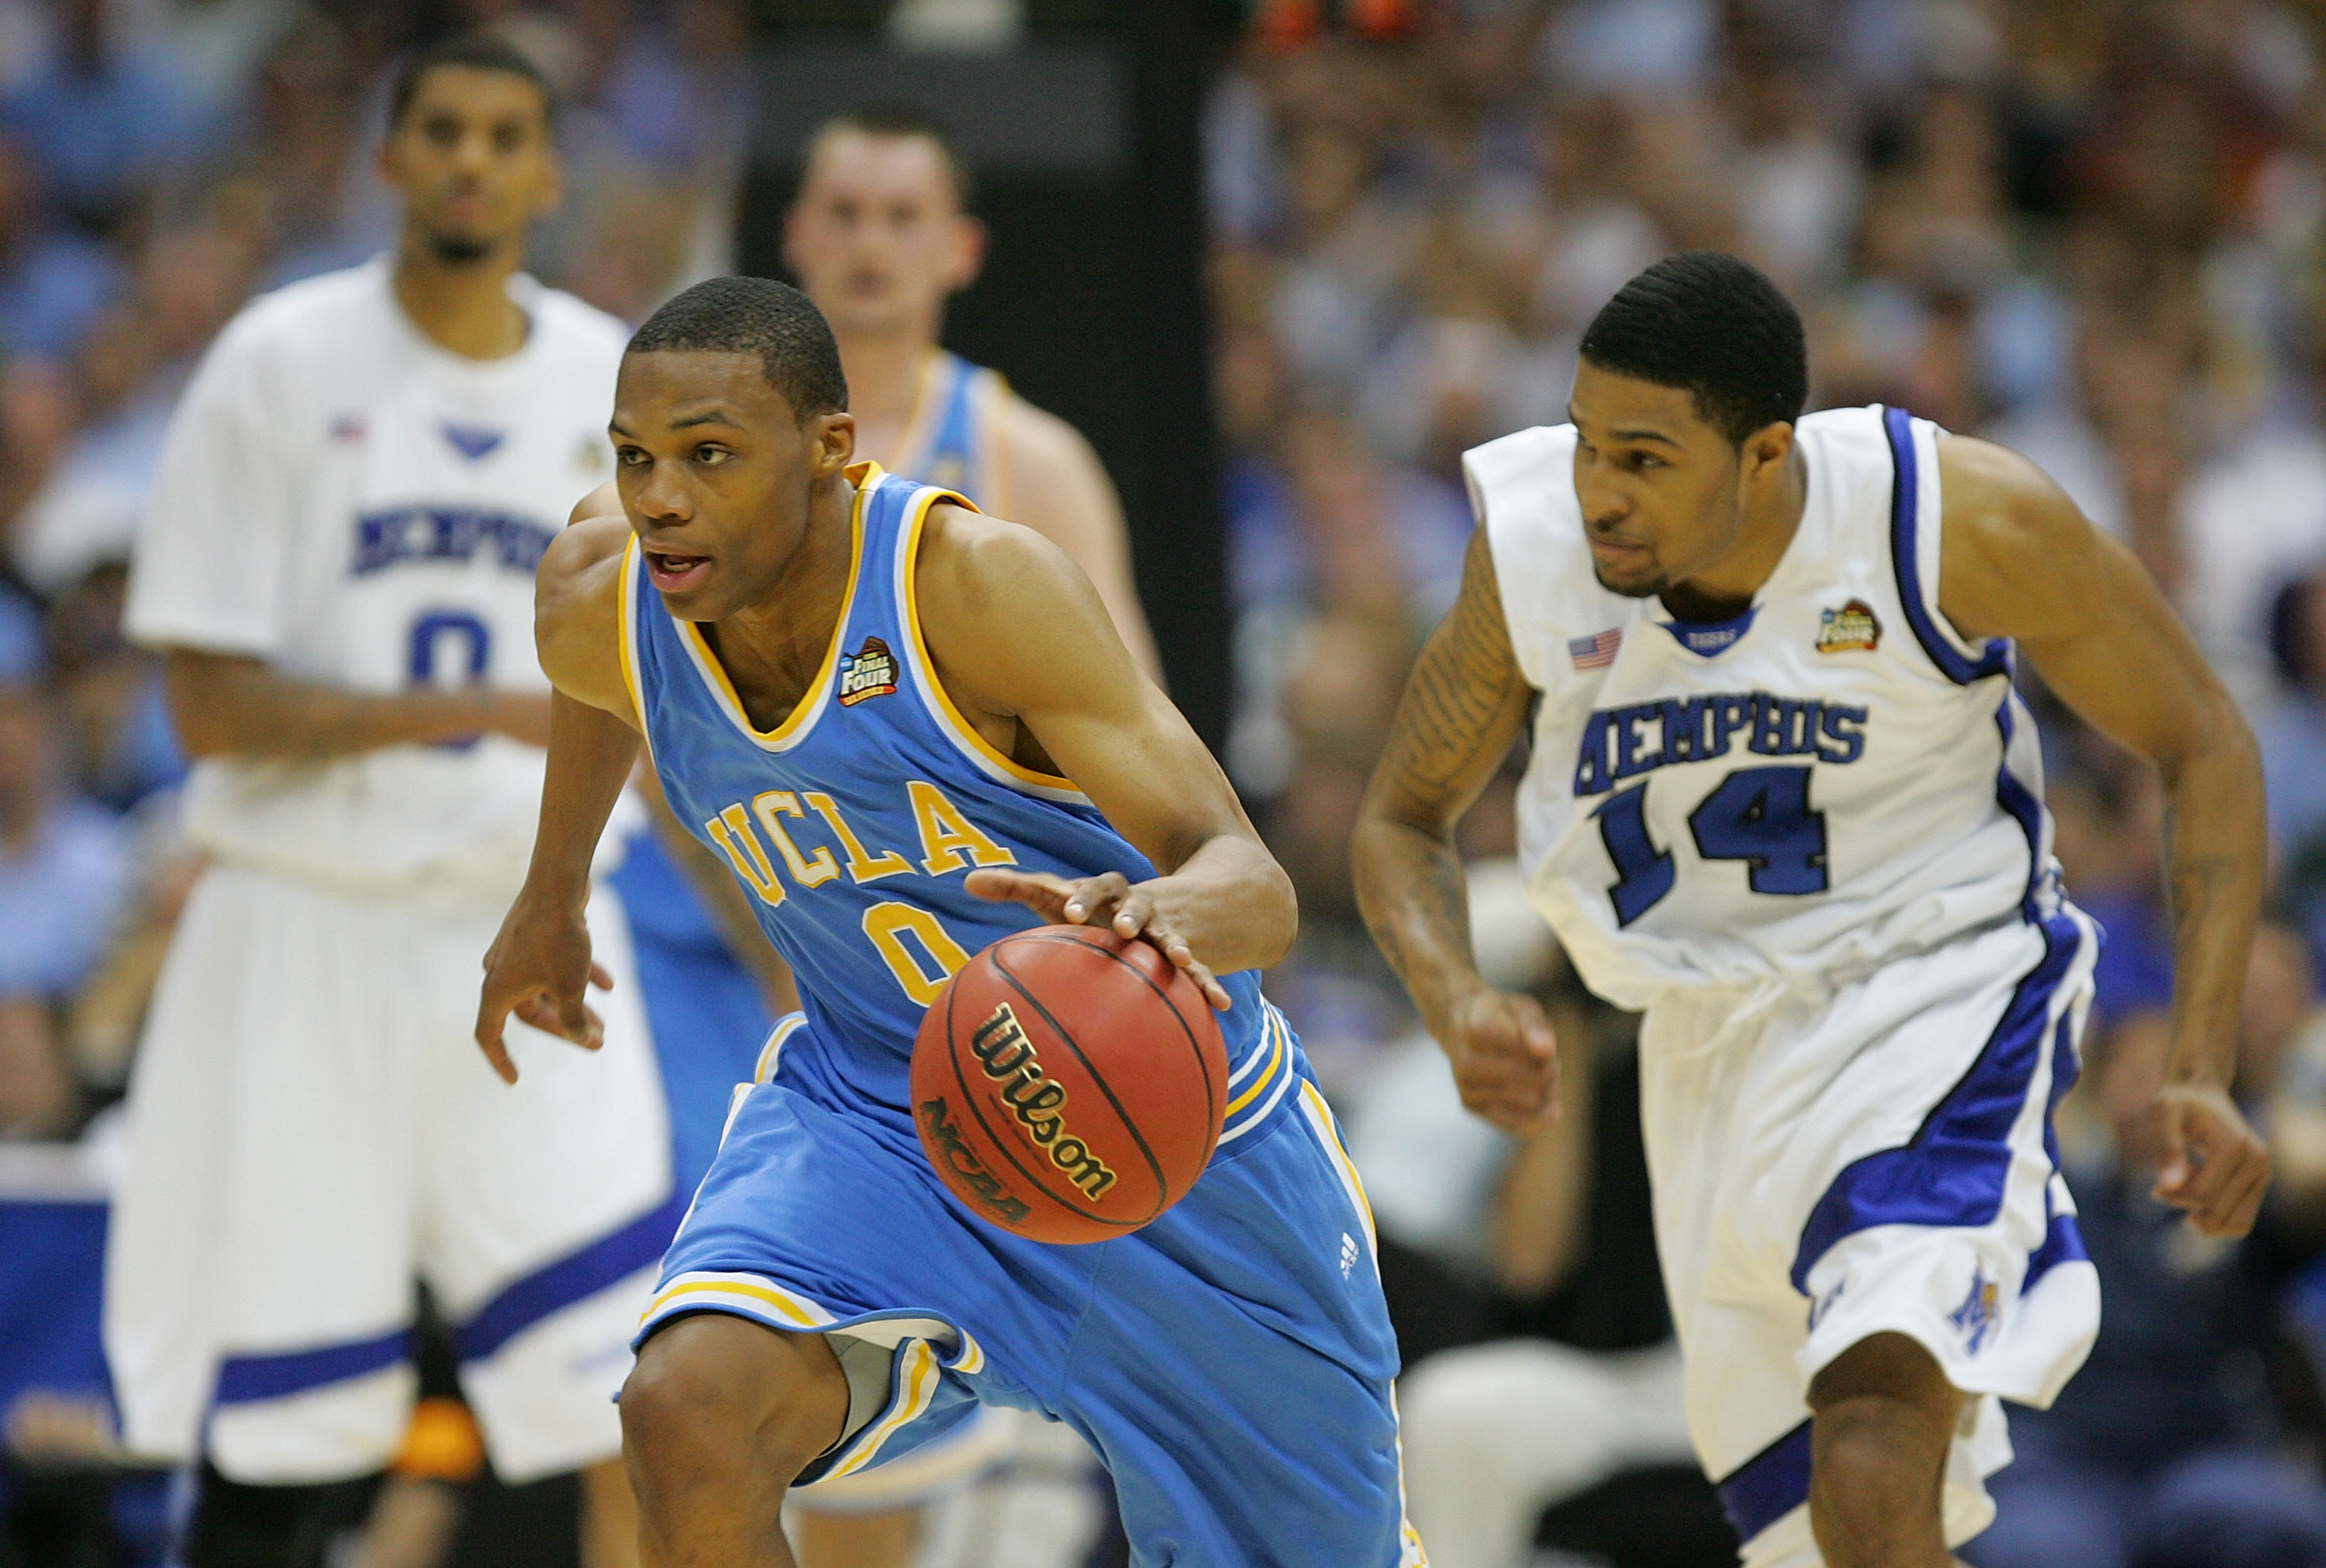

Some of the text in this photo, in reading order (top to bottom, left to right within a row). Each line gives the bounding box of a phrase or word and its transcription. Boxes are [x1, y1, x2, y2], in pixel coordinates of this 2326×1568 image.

[841, 667, 892, 695] FOUR
[1574, 691, 1868, 796] MEMPHIS
[705, 781, 1018, 907] UCLA
[1588, 765, 1831, 929] 14
[861, 901, 971, 1008] 0
[920, 1096, 1032, 1223] NCAA
[971, 1001, 1118, 1202] Wilson
